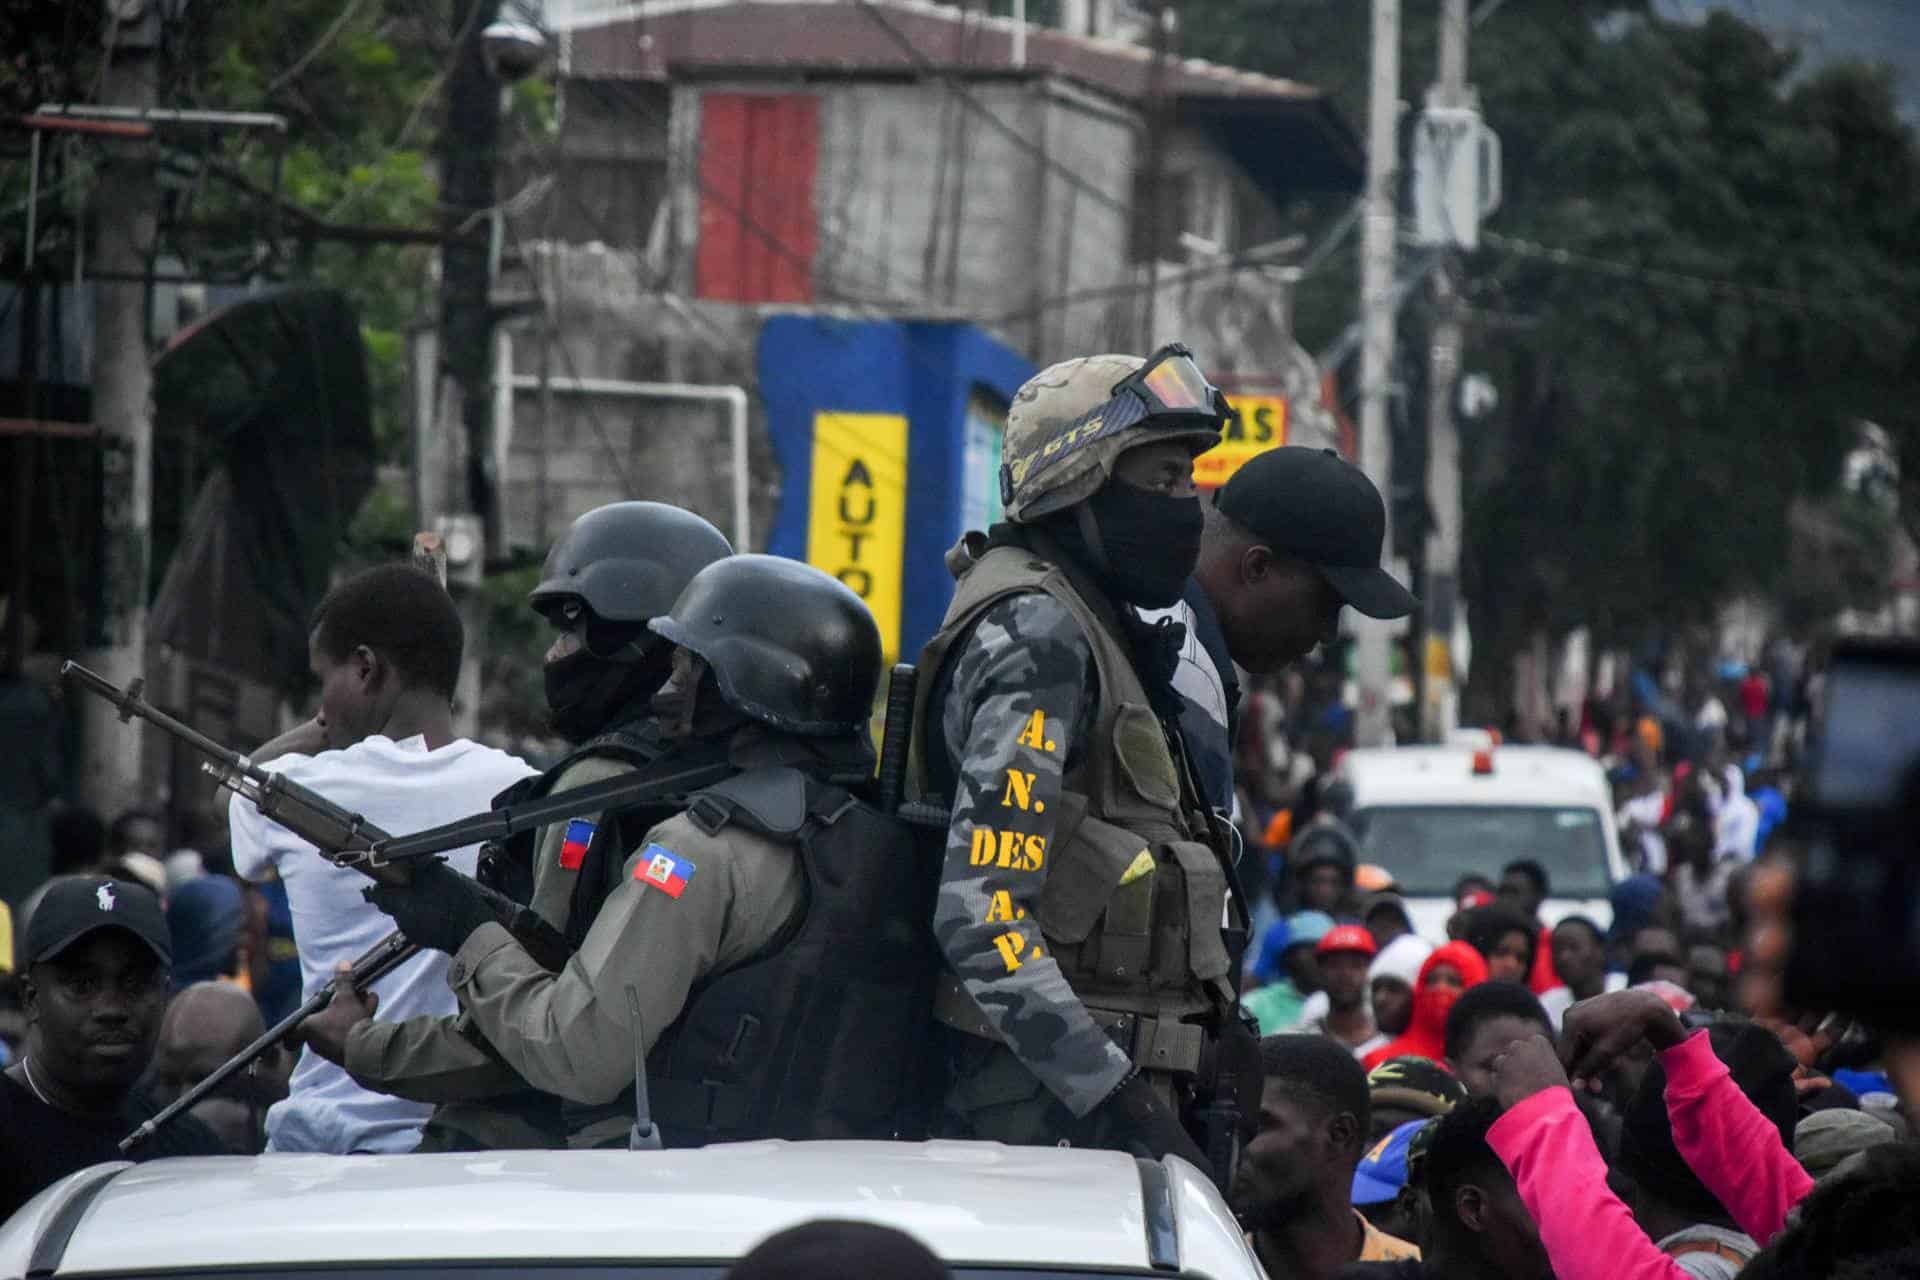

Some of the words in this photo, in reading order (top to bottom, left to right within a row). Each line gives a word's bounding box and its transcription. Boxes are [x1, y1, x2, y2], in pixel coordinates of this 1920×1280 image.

[1017, 708, 1056, 752] A.
[1001, 768, 1045, 813] N.
[969, 828, 1047, 872] DES
[985, 889, 1025, 922] A.
[993, 931, 1044, 972] P.
